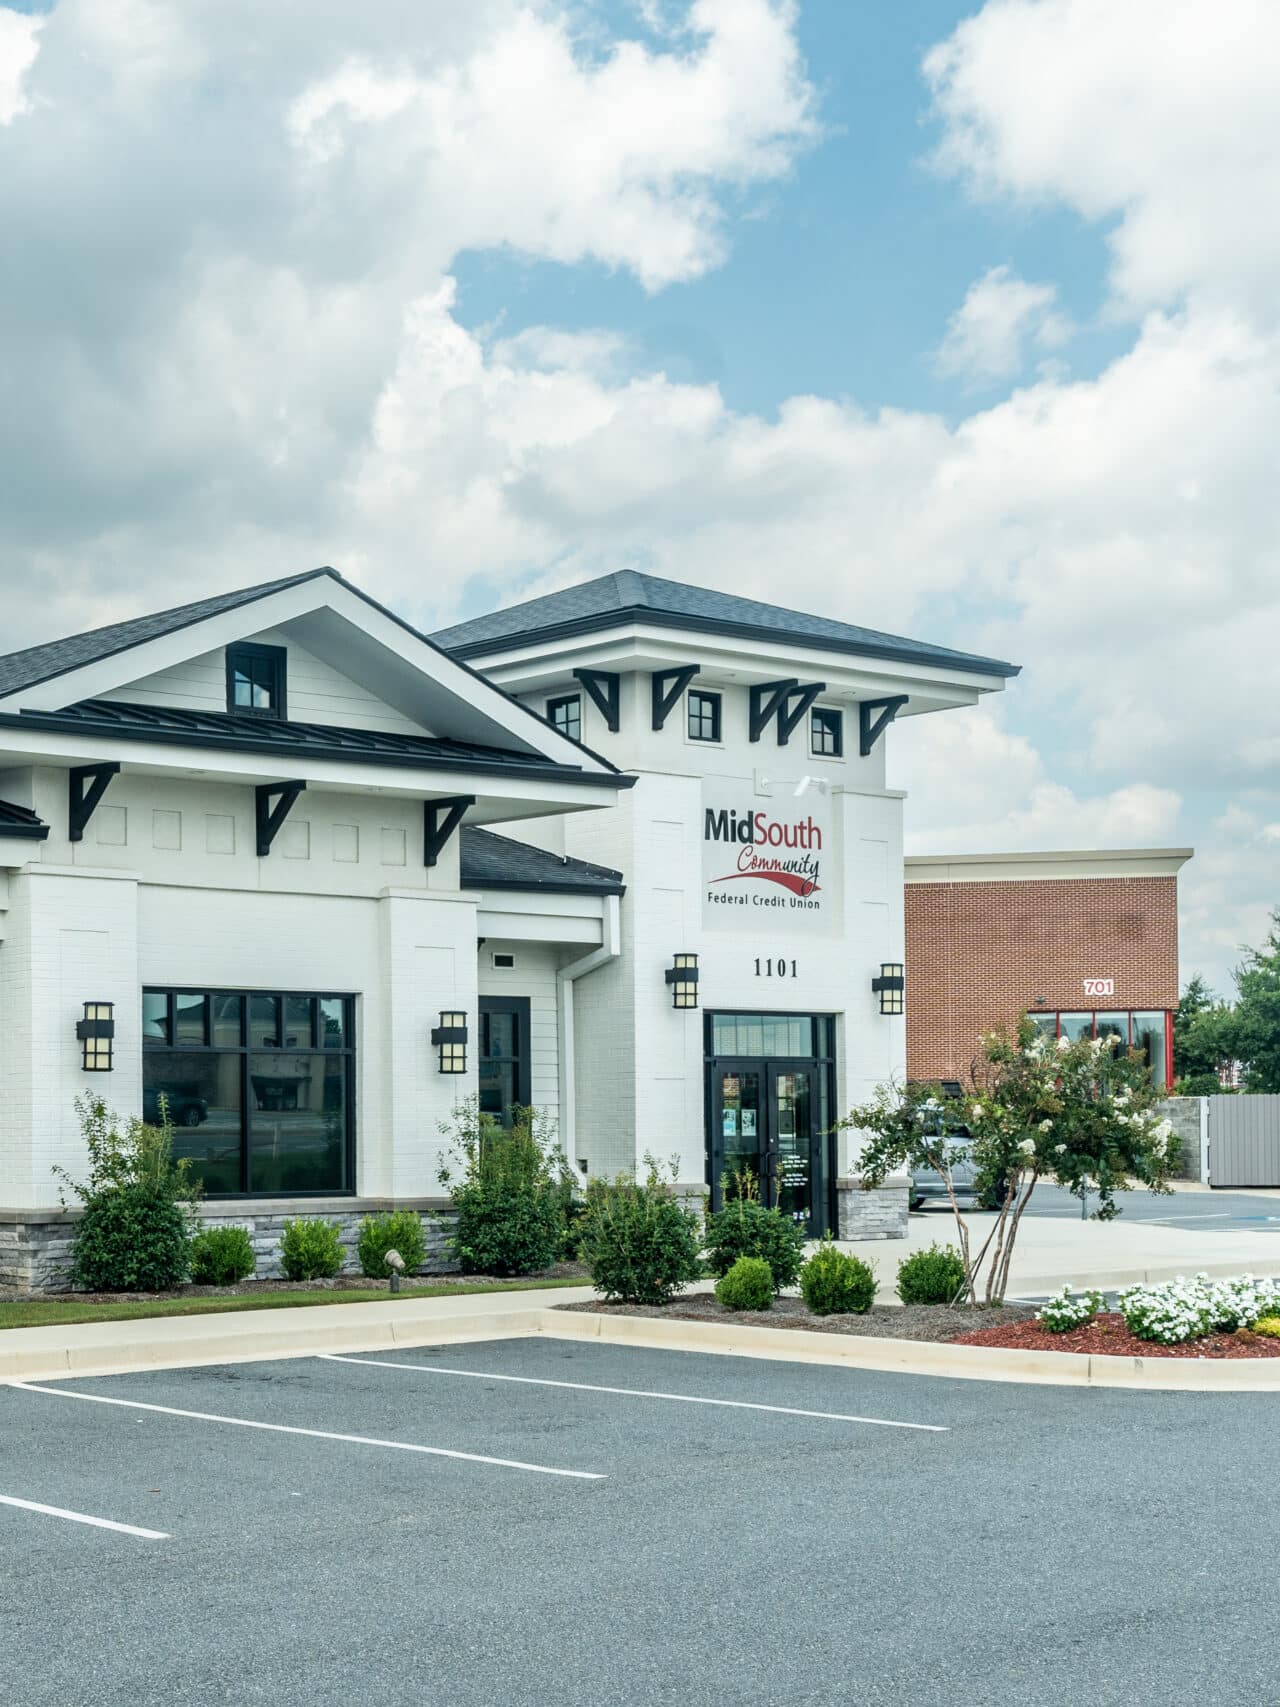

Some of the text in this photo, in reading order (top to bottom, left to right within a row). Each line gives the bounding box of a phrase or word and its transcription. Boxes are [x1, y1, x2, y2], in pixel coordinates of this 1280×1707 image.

[704, 808, 822, 850] MidSouth
[737, 845, 820, 898] Community
[707, 892, 820, 910] Federal Credit Union
[754, 958, 798, 978] 1101
[1085, 980, 1112, 994] 701
